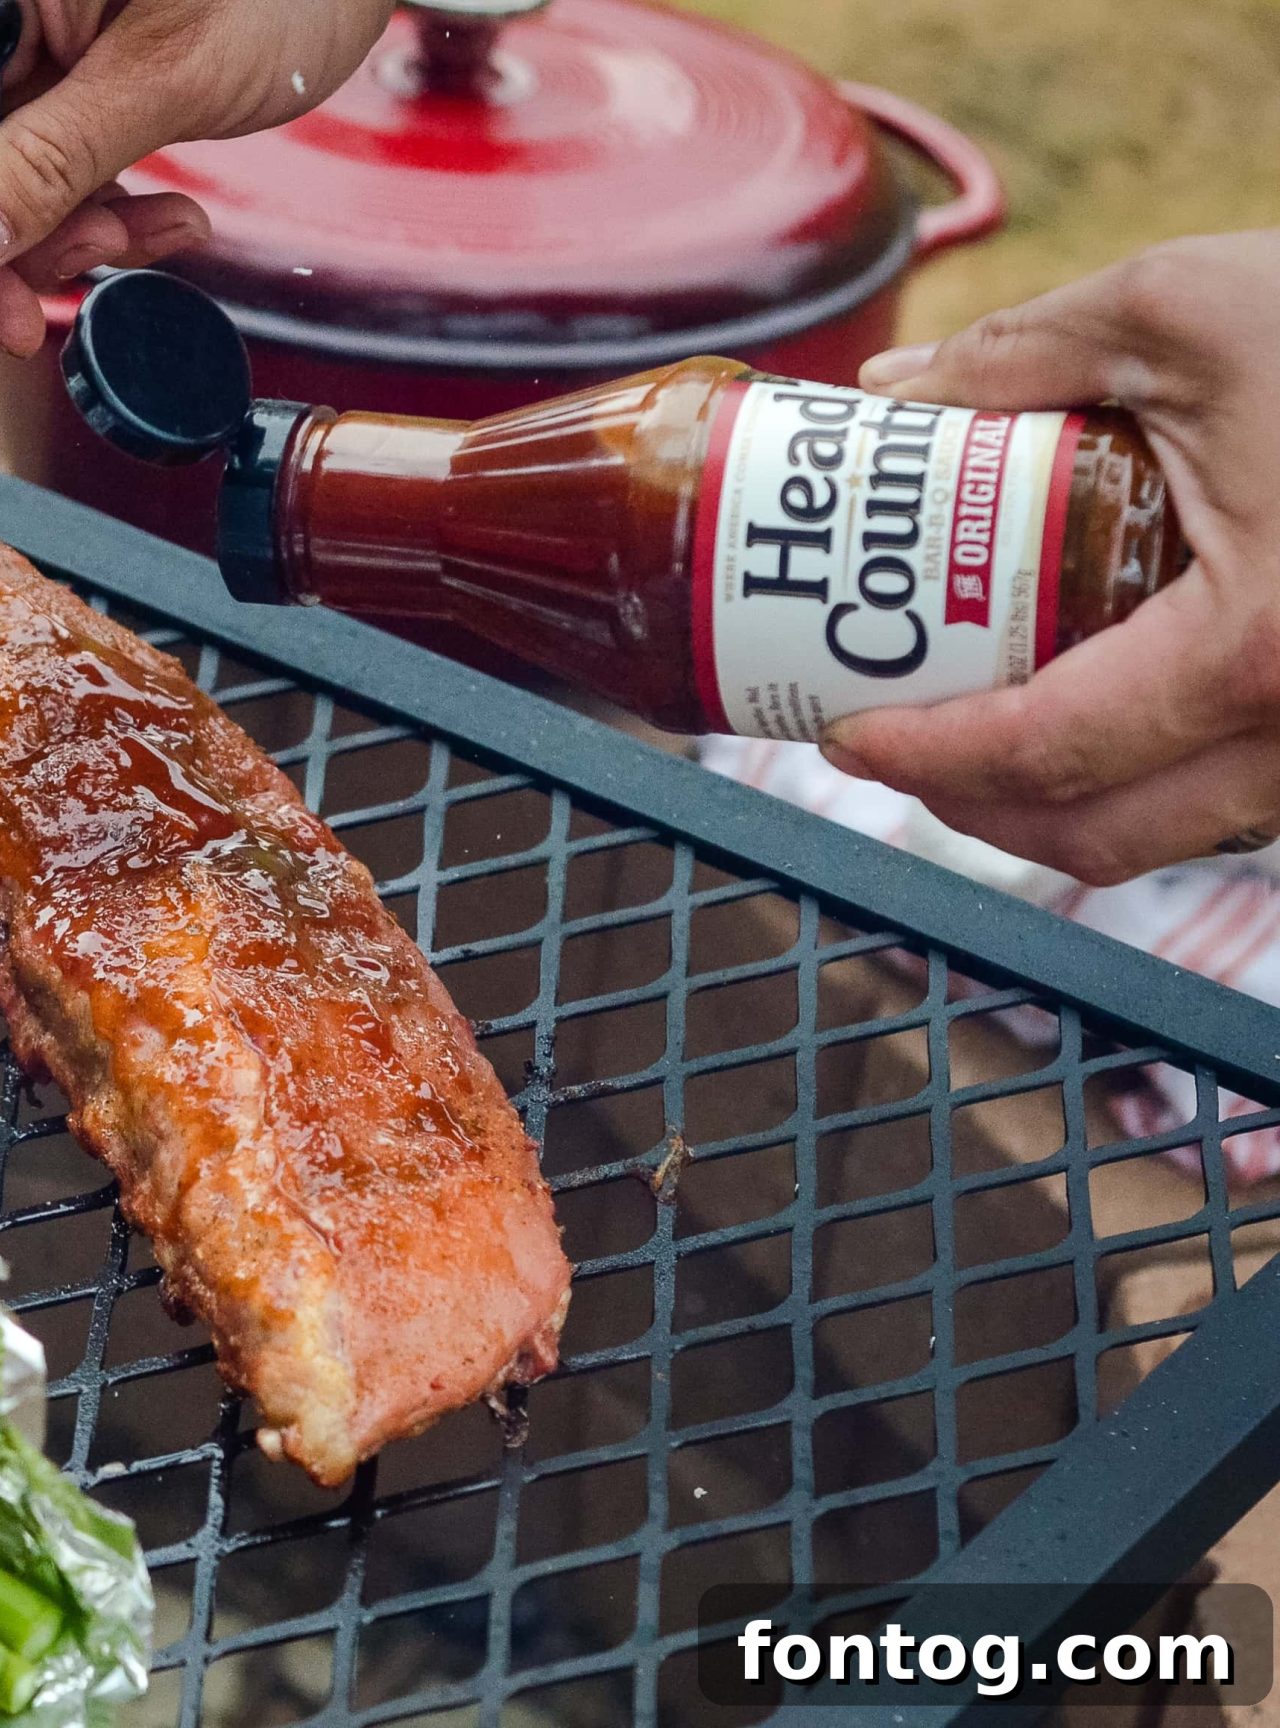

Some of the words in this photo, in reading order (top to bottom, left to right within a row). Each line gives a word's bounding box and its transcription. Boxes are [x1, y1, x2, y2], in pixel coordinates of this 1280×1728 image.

[742, 391, 862, 604] Head
[825, 404, 945, 678] Countr
[952, 415, 1012, 567] ORIGINAL
